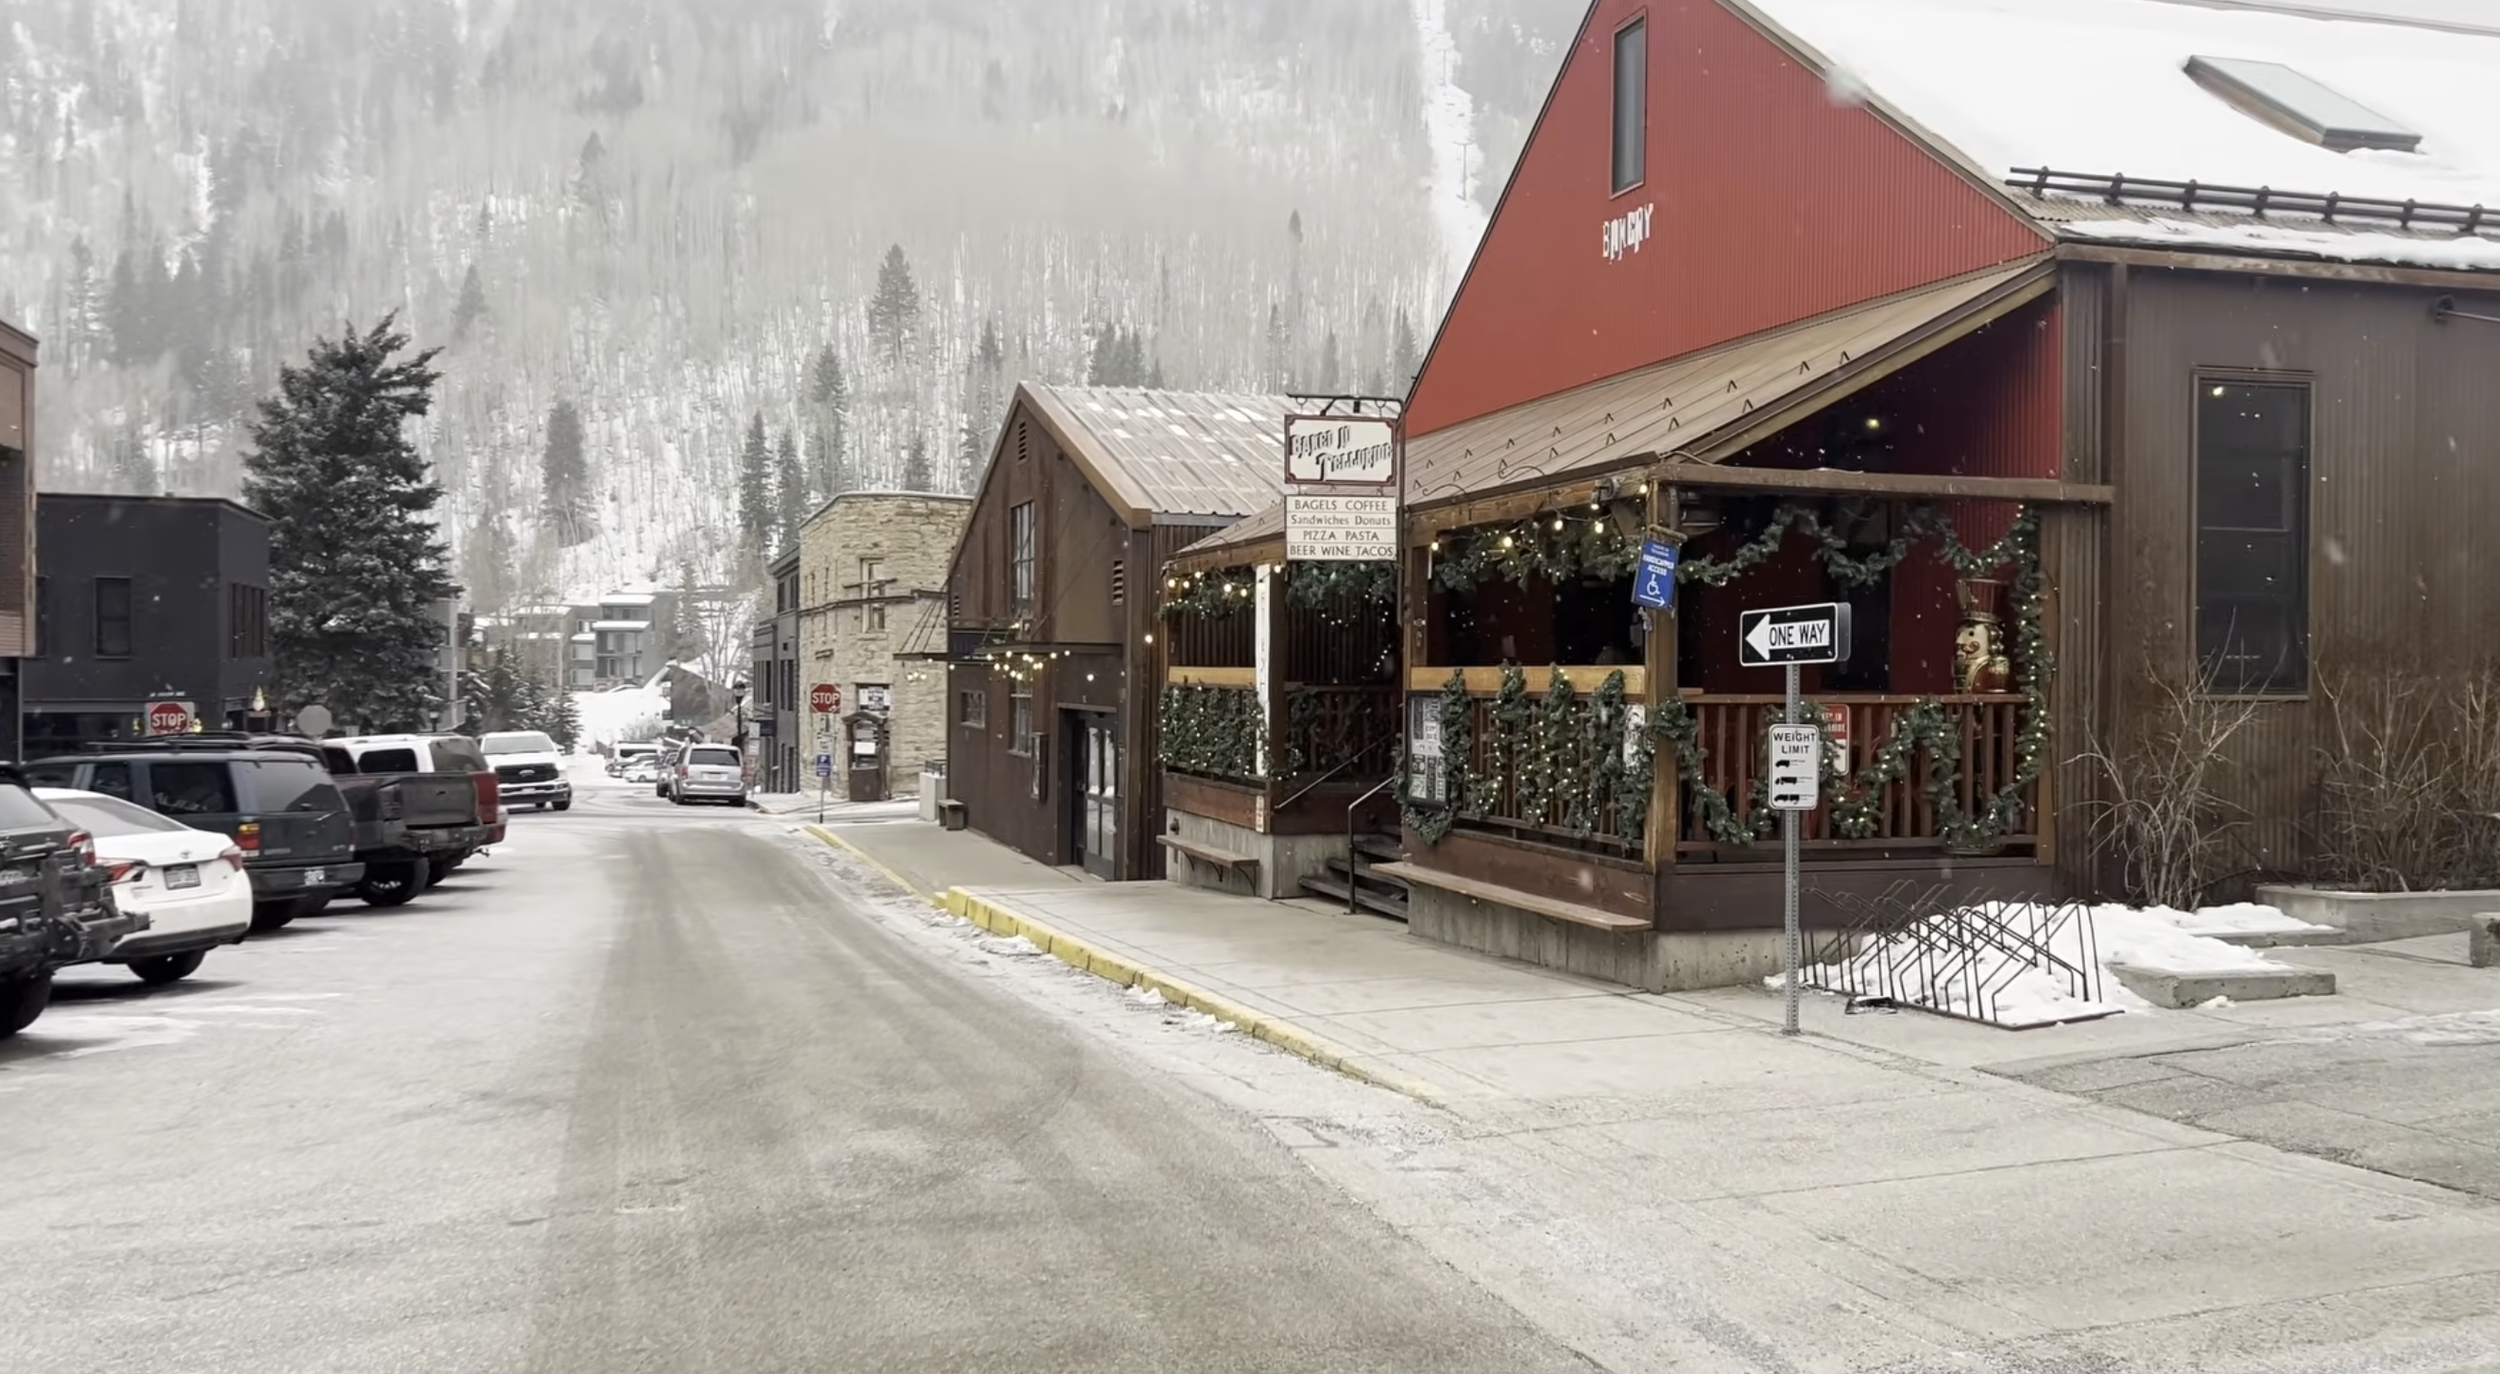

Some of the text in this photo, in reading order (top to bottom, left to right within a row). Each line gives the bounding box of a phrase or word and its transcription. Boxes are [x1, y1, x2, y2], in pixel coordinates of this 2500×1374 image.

[1602, 203, 1654, 261] BAKERY
[1294, 500, 1388, 511] BAGELS COFFEE
[1291, 514, 1391, 526] Sandwiches Donuts
[1303, 530, 1380, 542] PIZZA PASTA
[1290, 545, 1393, 557] BEER WINE TACOS
[1769, 622, 1826, 646] ONE WAY
[811, 692, 840, 704] STOP
[152, 712, 186, 727] STOP
[1773, 732, 1816, 742] WEIGHT
[1781, 745, 1810, 754] LIMIT
